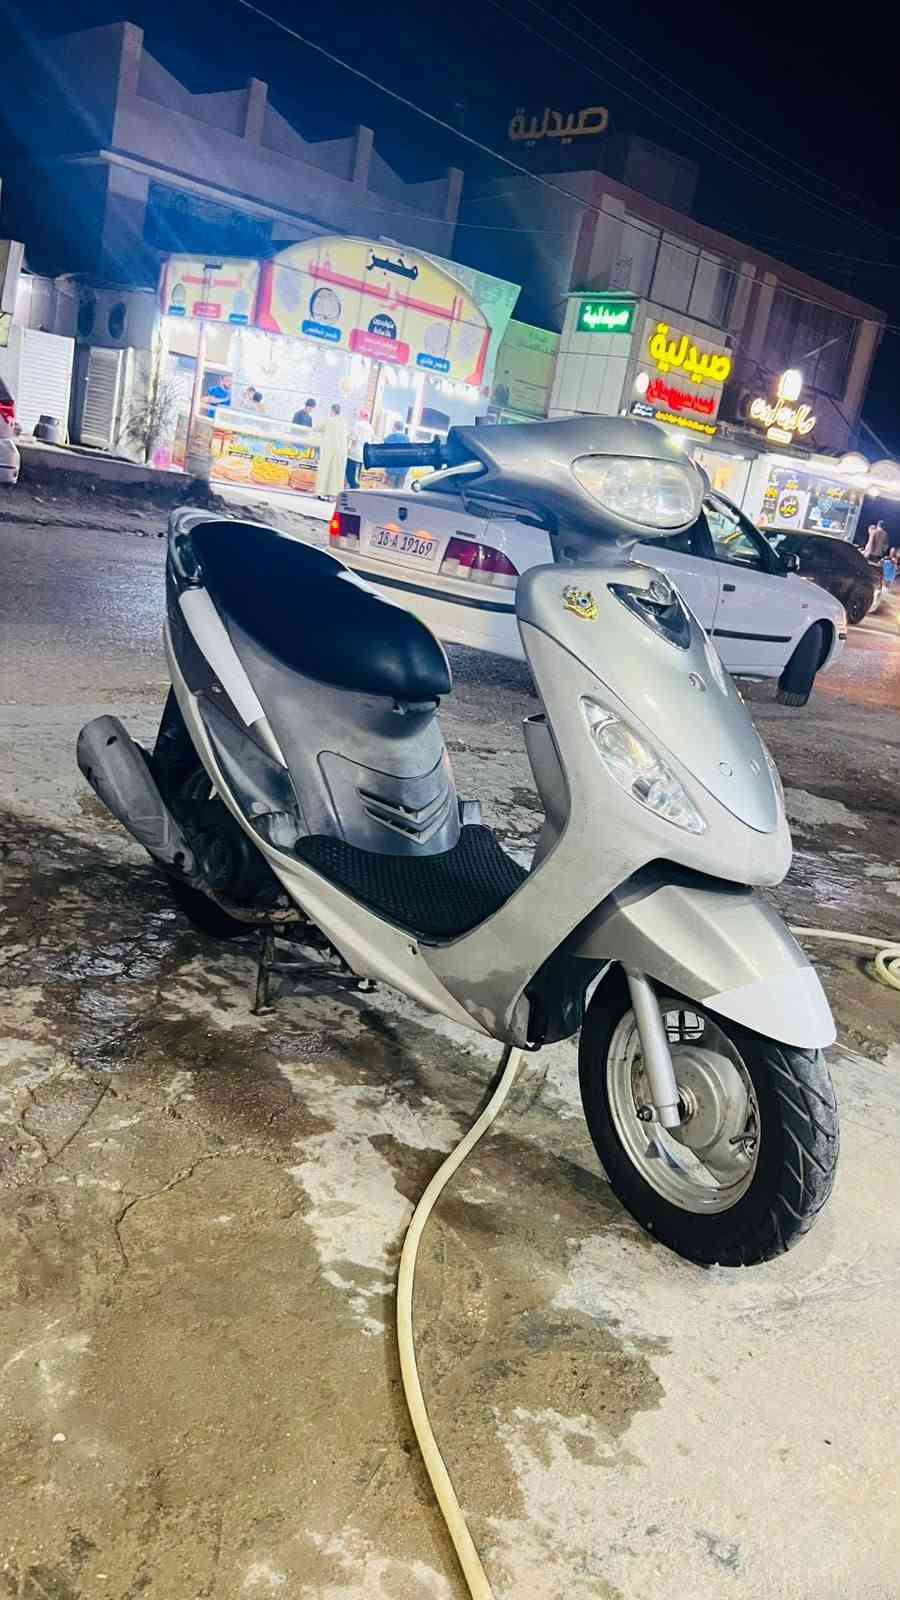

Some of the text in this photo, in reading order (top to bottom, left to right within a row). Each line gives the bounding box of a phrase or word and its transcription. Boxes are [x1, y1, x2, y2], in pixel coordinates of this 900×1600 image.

[508, 106, 609, 147] صيدلية
[366, 249, 419, 281] مخبز
[583, 304, 630, 329] صيدلية
[649, 322, 733, 384] صيدلية
[400, 535, 433, 557] 19169
